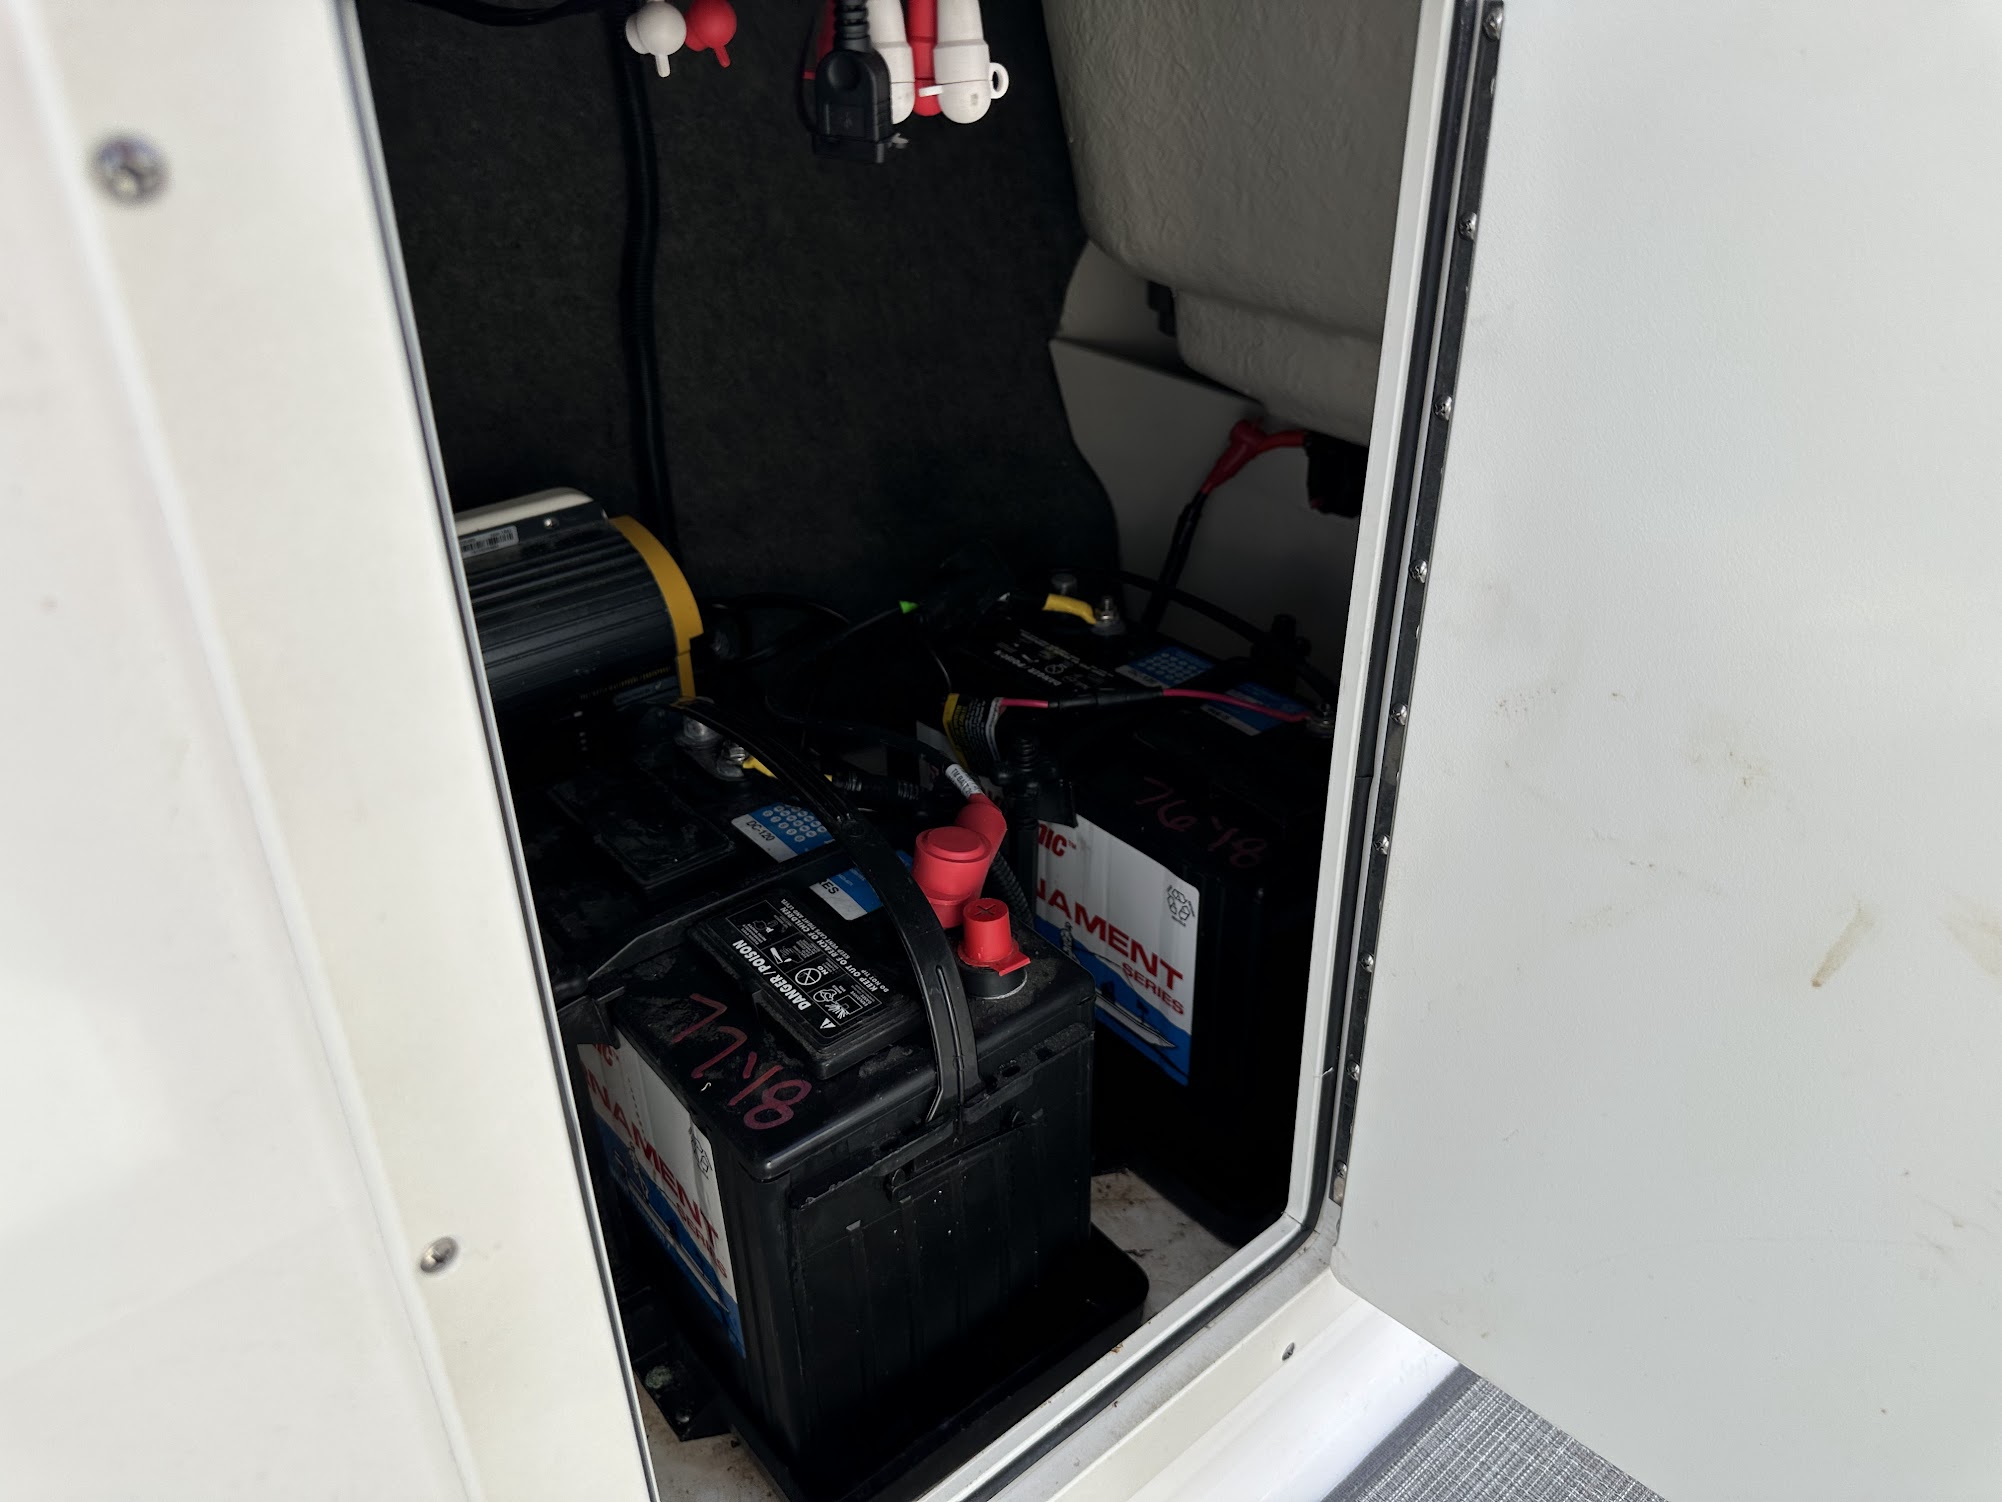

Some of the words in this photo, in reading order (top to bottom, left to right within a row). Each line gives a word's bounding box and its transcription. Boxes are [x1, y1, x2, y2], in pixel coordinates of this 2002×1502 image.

[746, 819, 775, 842] DC-120
[780, 907, 810, 932] CHILDREN
[808, 932, 819, 940] OF
[733, 940, 771, 972] POISON
[817, 939, 838, 957] REACH
[836, 957, 847, 965] OF
[817, 966, 829, 975] NO
[845, 965, 861, 977] OUT
[770, 974, 811, 1010] DANGER
[859, 977, 878, 992] KEEP
[1122, 962, 1185, 1016] SERIES
